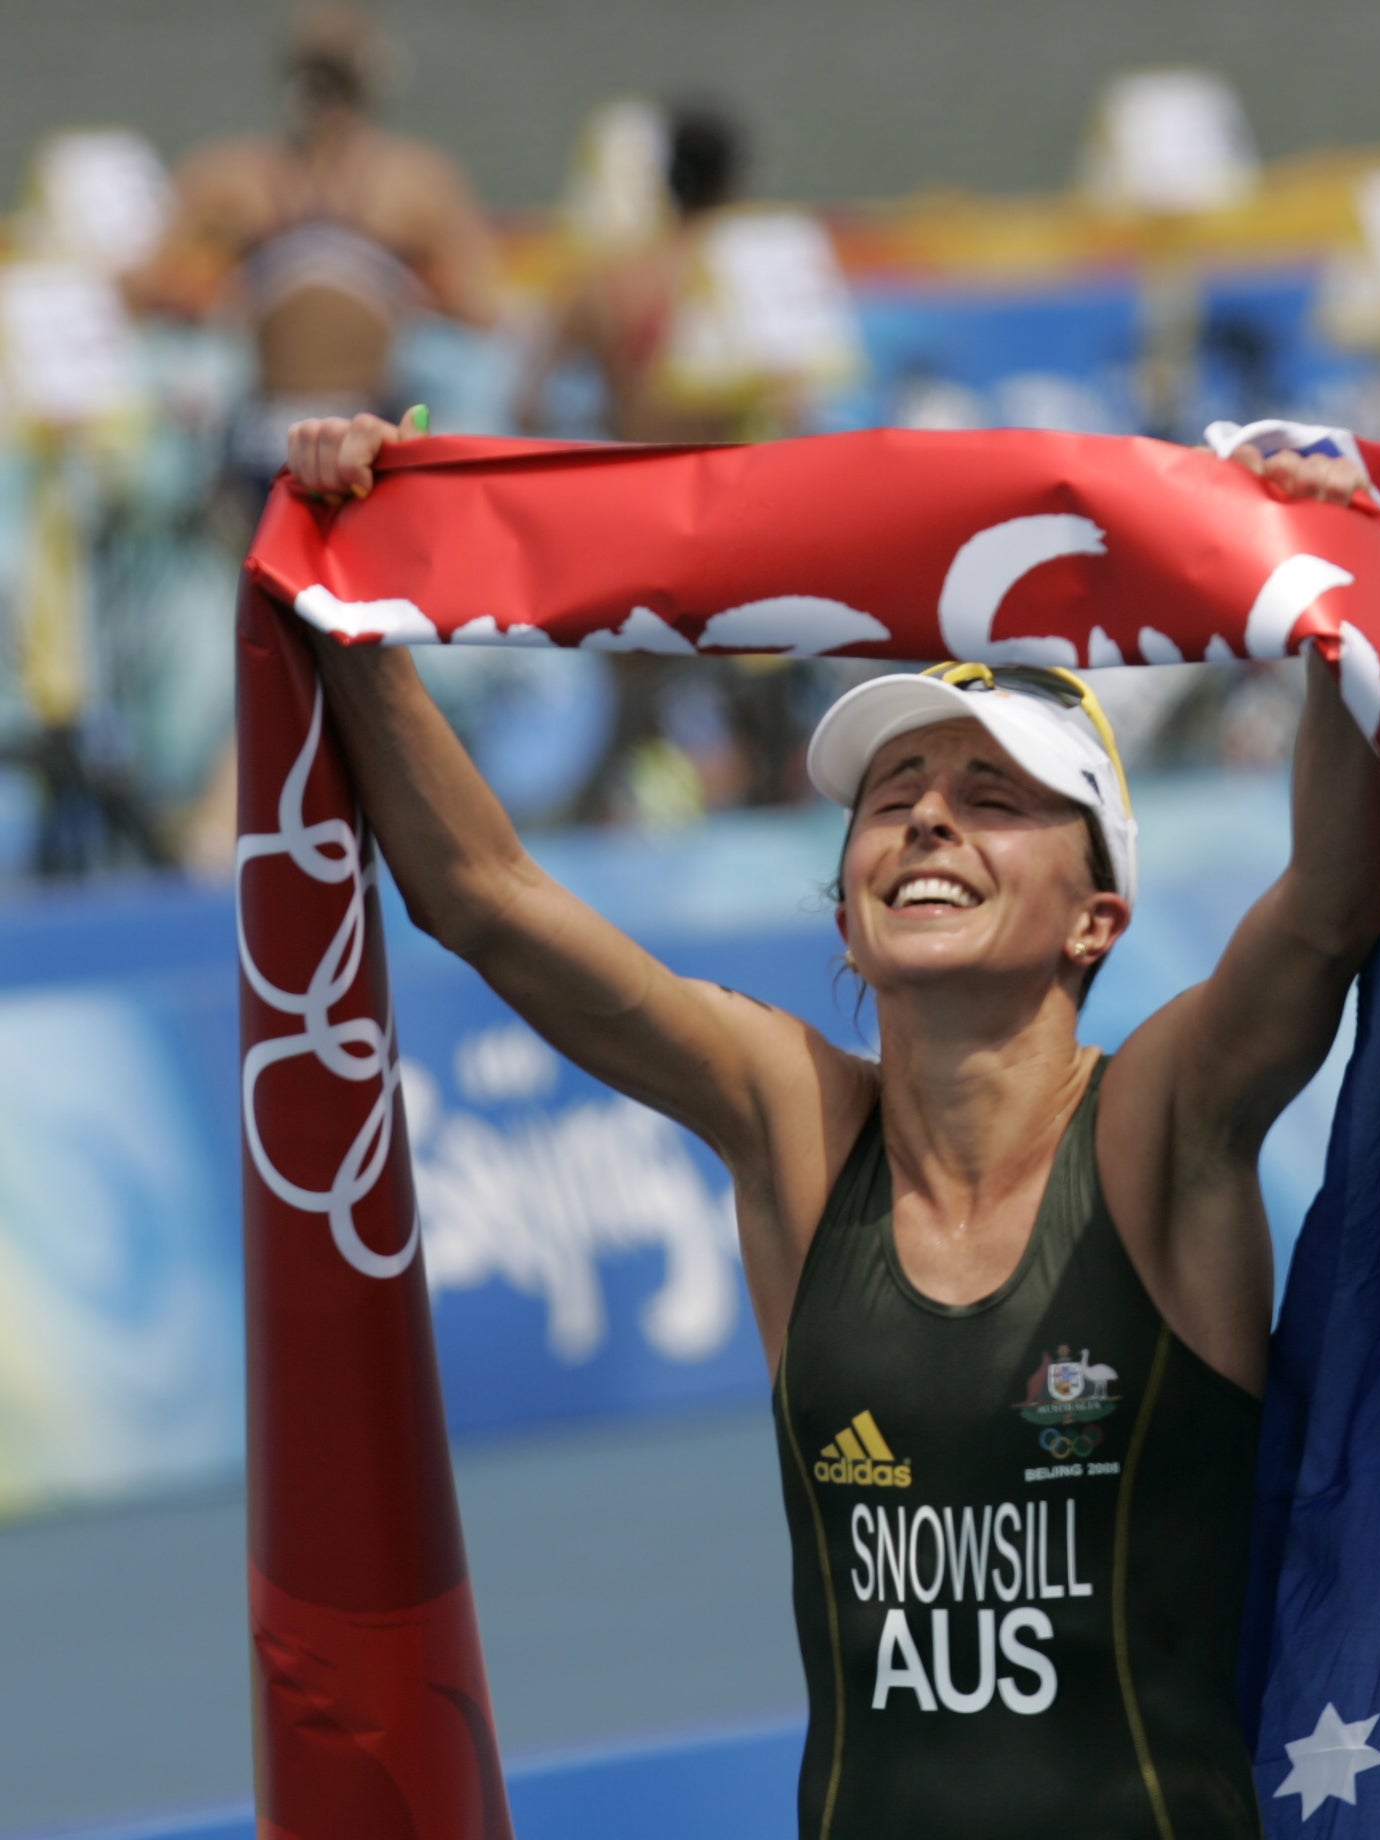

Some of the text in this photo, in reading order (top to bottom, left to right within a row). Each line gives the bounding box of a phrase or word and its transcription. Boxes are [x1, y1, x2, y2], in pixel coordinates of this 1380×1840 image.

[814, 1458, 911, 1487] adidas
[1024, 1463, 1083, 1482] BEIJING
[851, 1499, 1092, 1602] SNOWSILL
[871, 1607, 1056, 1714] AUS
